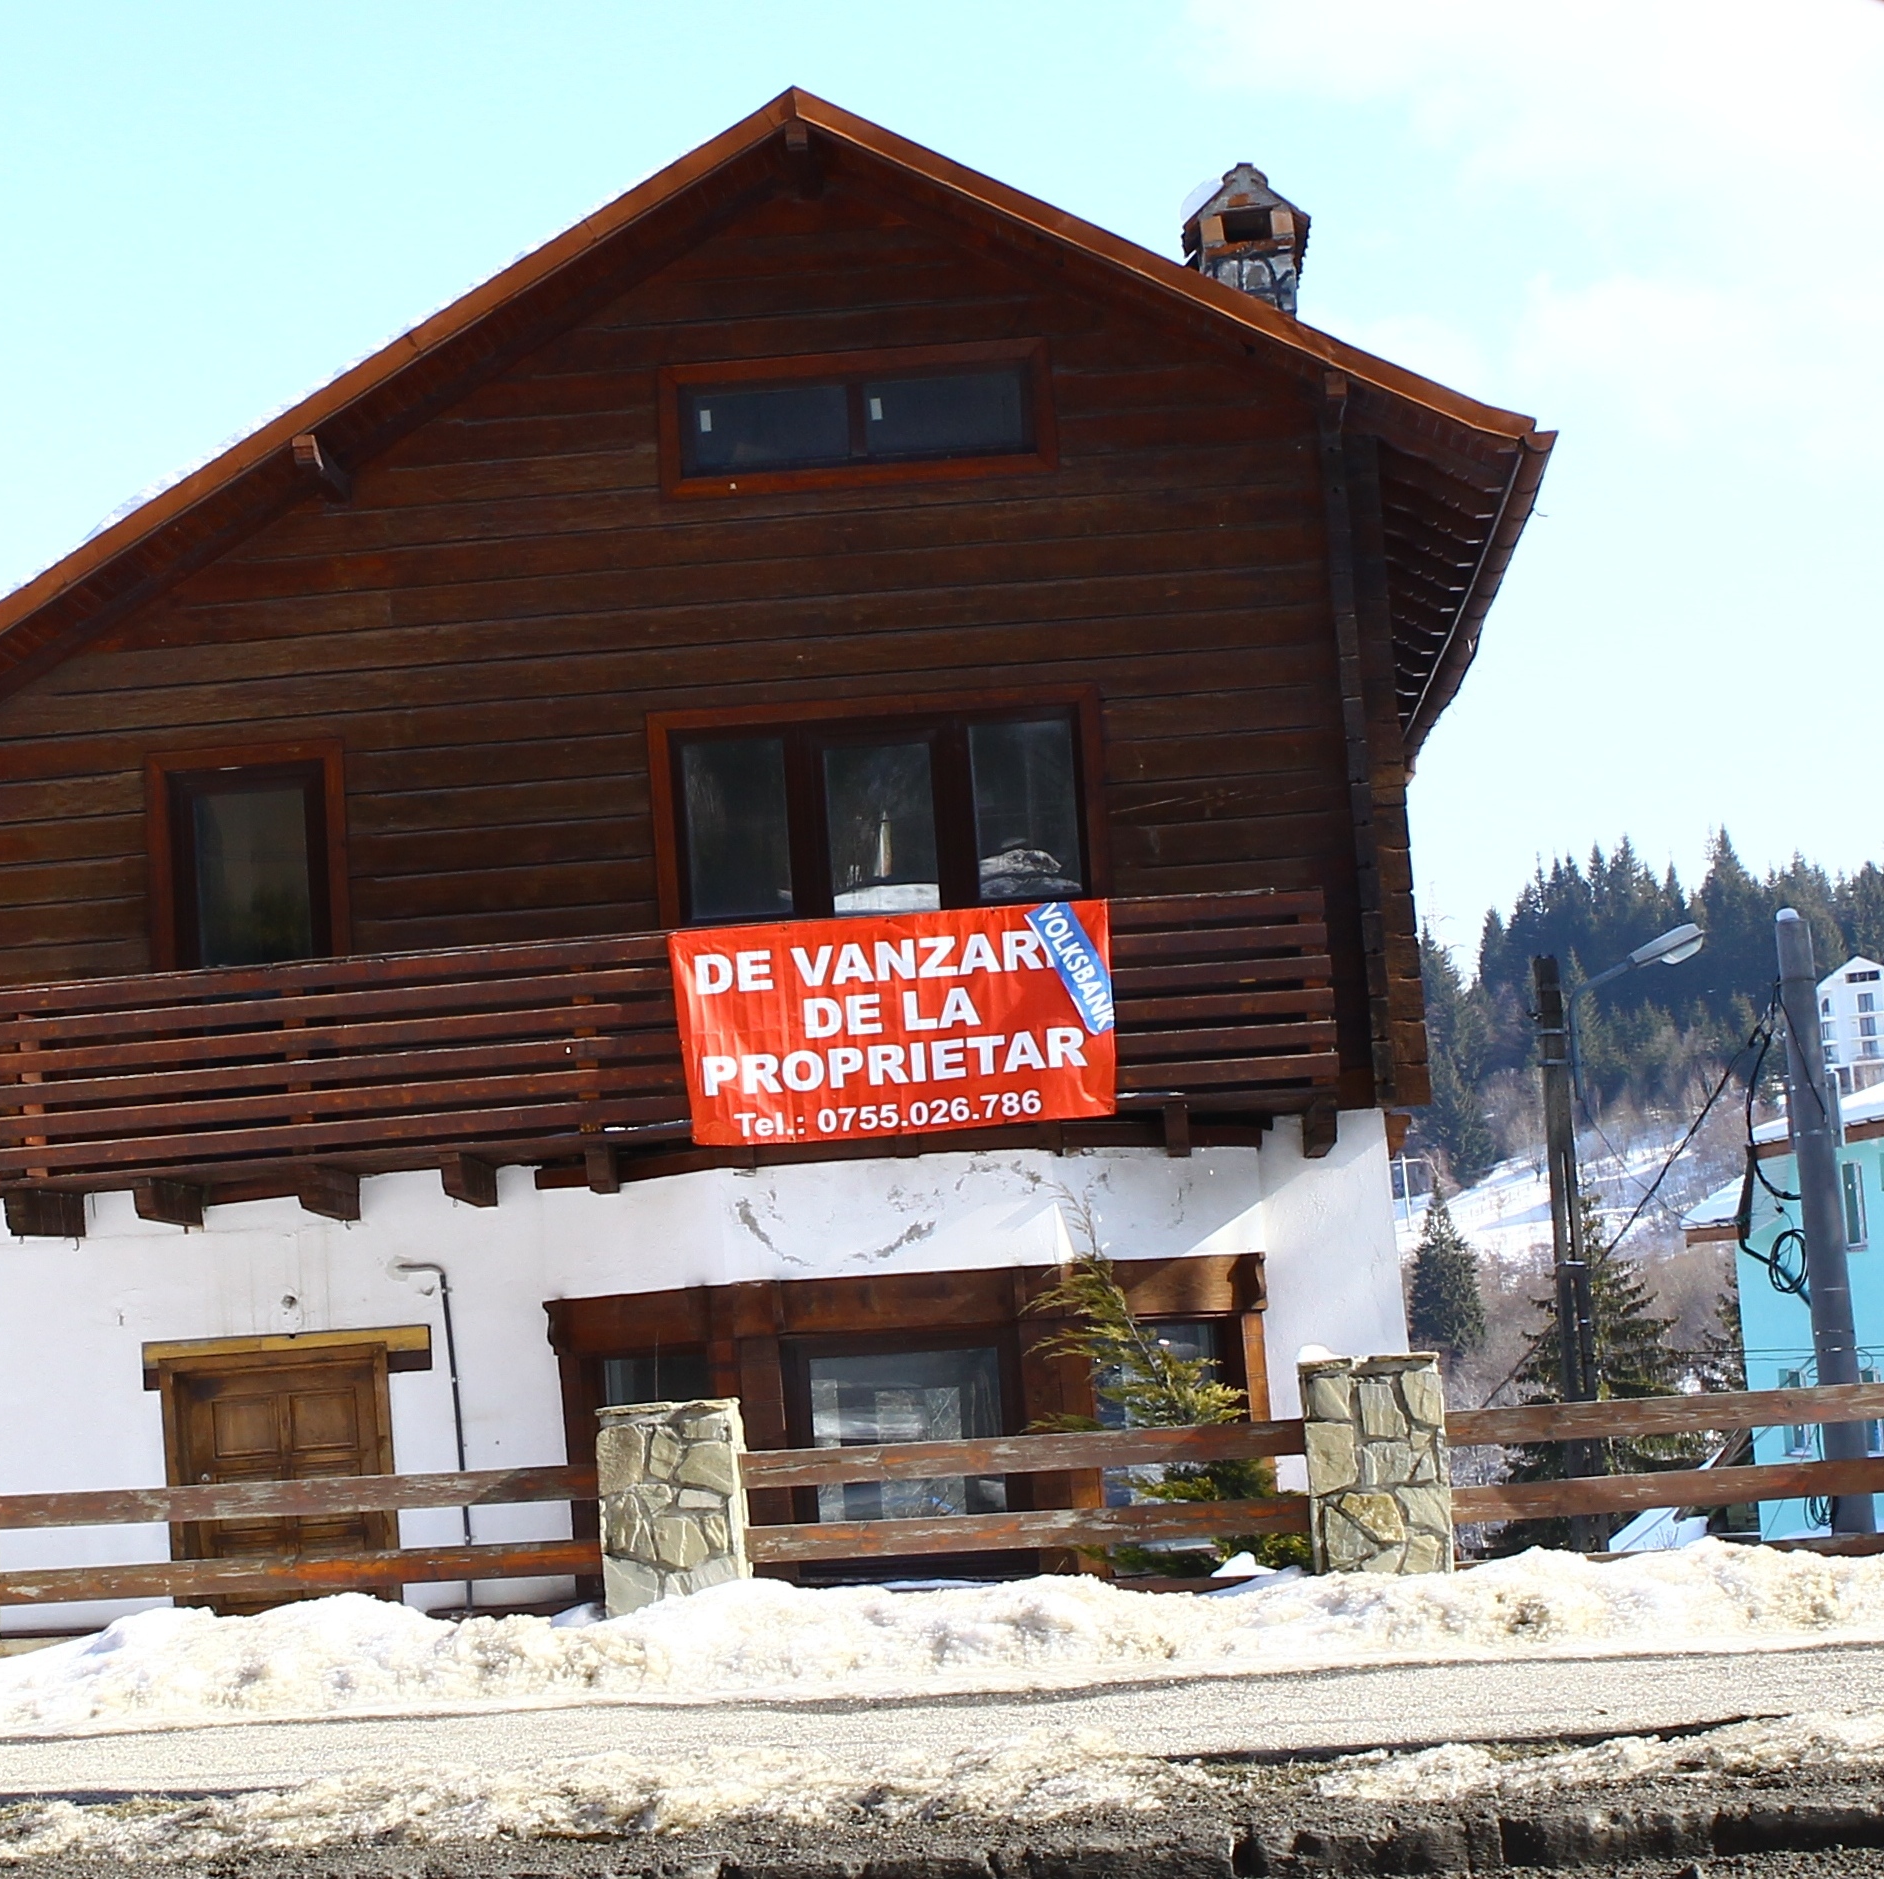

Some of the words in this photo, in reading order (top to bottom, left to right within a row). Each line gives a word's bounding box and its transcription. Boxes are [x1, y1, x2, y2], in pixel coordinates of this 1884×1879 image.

[693, 949, 774, 995] DE
[790, 930, 1054, 987] VANZAR
[1038, 902, 1114, 1031] VOLKSBANK
[803, 993, 883, 1039] DE
[904, 987, 981, 1031] LA
[701, 1026, 1087, 1097] PROPRIETAR
[734, 1111, 805, 1138] Tel.:
[817, 1089, 1042, 1133] 0755.026.786
